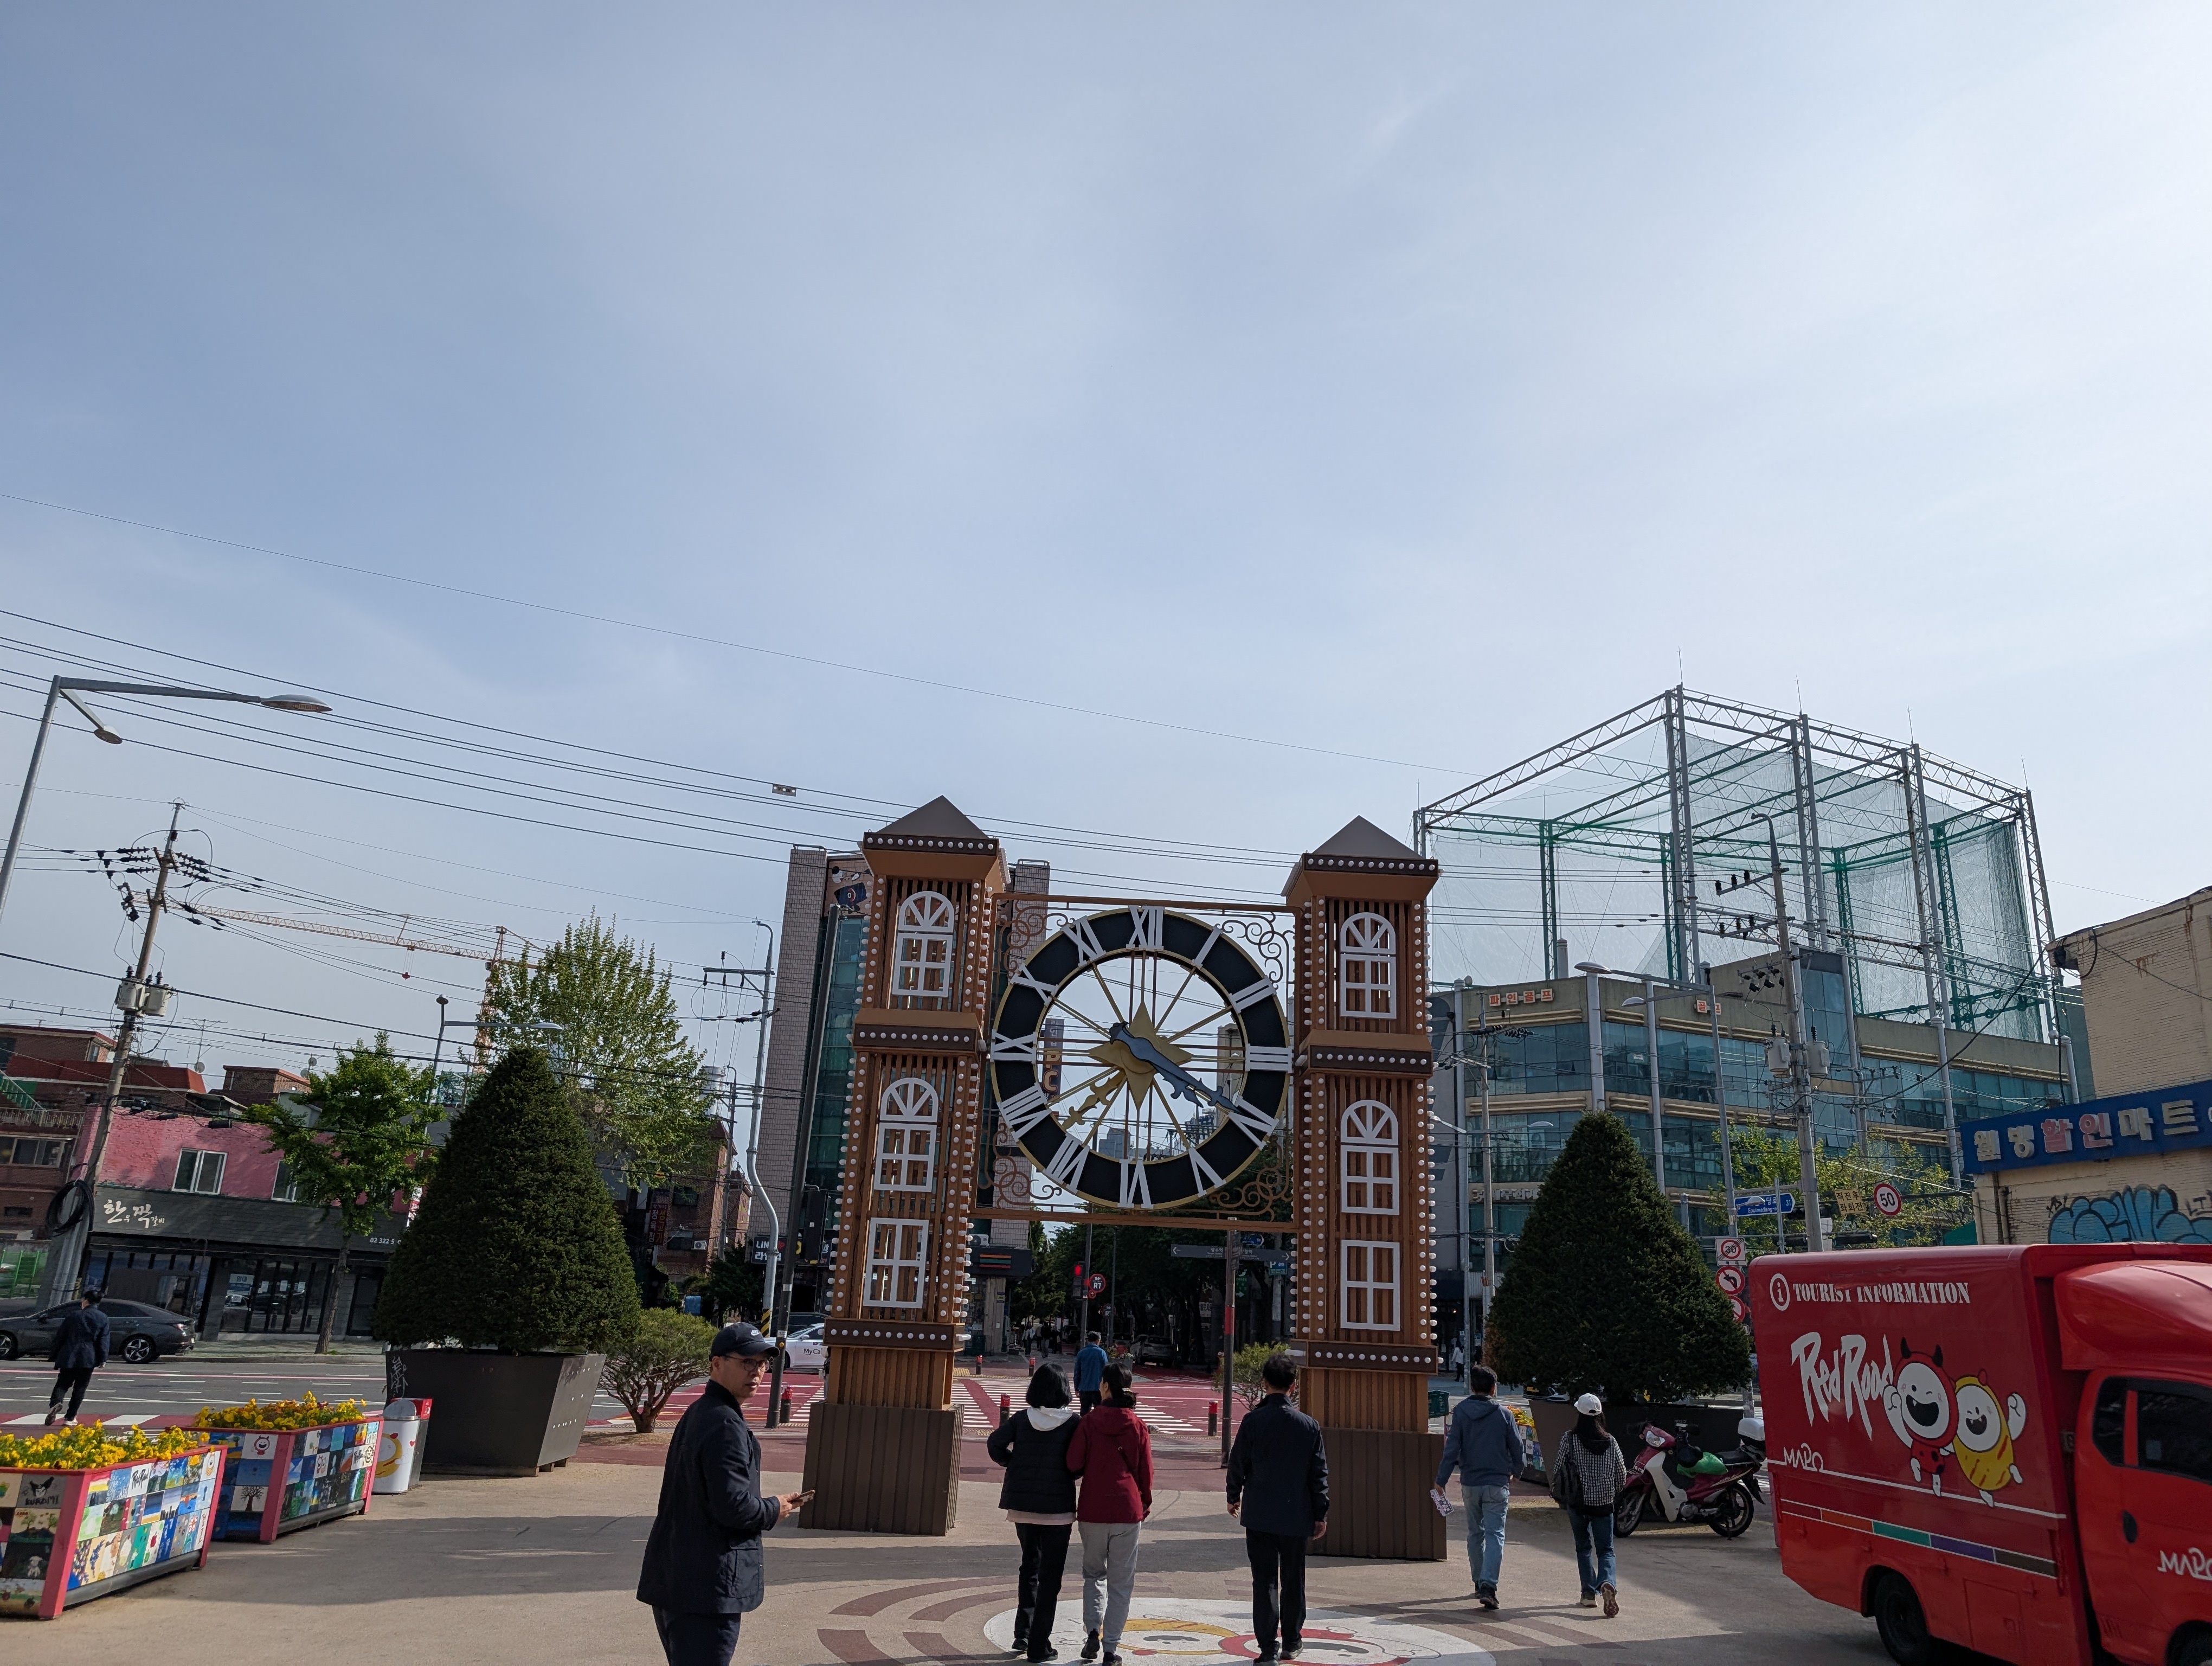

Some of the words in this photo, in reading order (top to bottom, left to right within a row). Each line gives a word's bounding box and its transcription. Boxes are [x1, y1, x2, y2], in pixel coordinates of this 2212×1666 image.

[1490, 990, 1552, 1005] 파인골프
[1836, 1191, 1860, 1201] 직진후
[1880, 1192, 1895, 1207] 50
[1840, 1202, 1864, 1212] 좌회전
[1725, 1245, 1737, 1253] 30
[1793, 1283, 1852, 1303] TOURIST
[1857, 1282, 1970, 1304] INFORMATION
